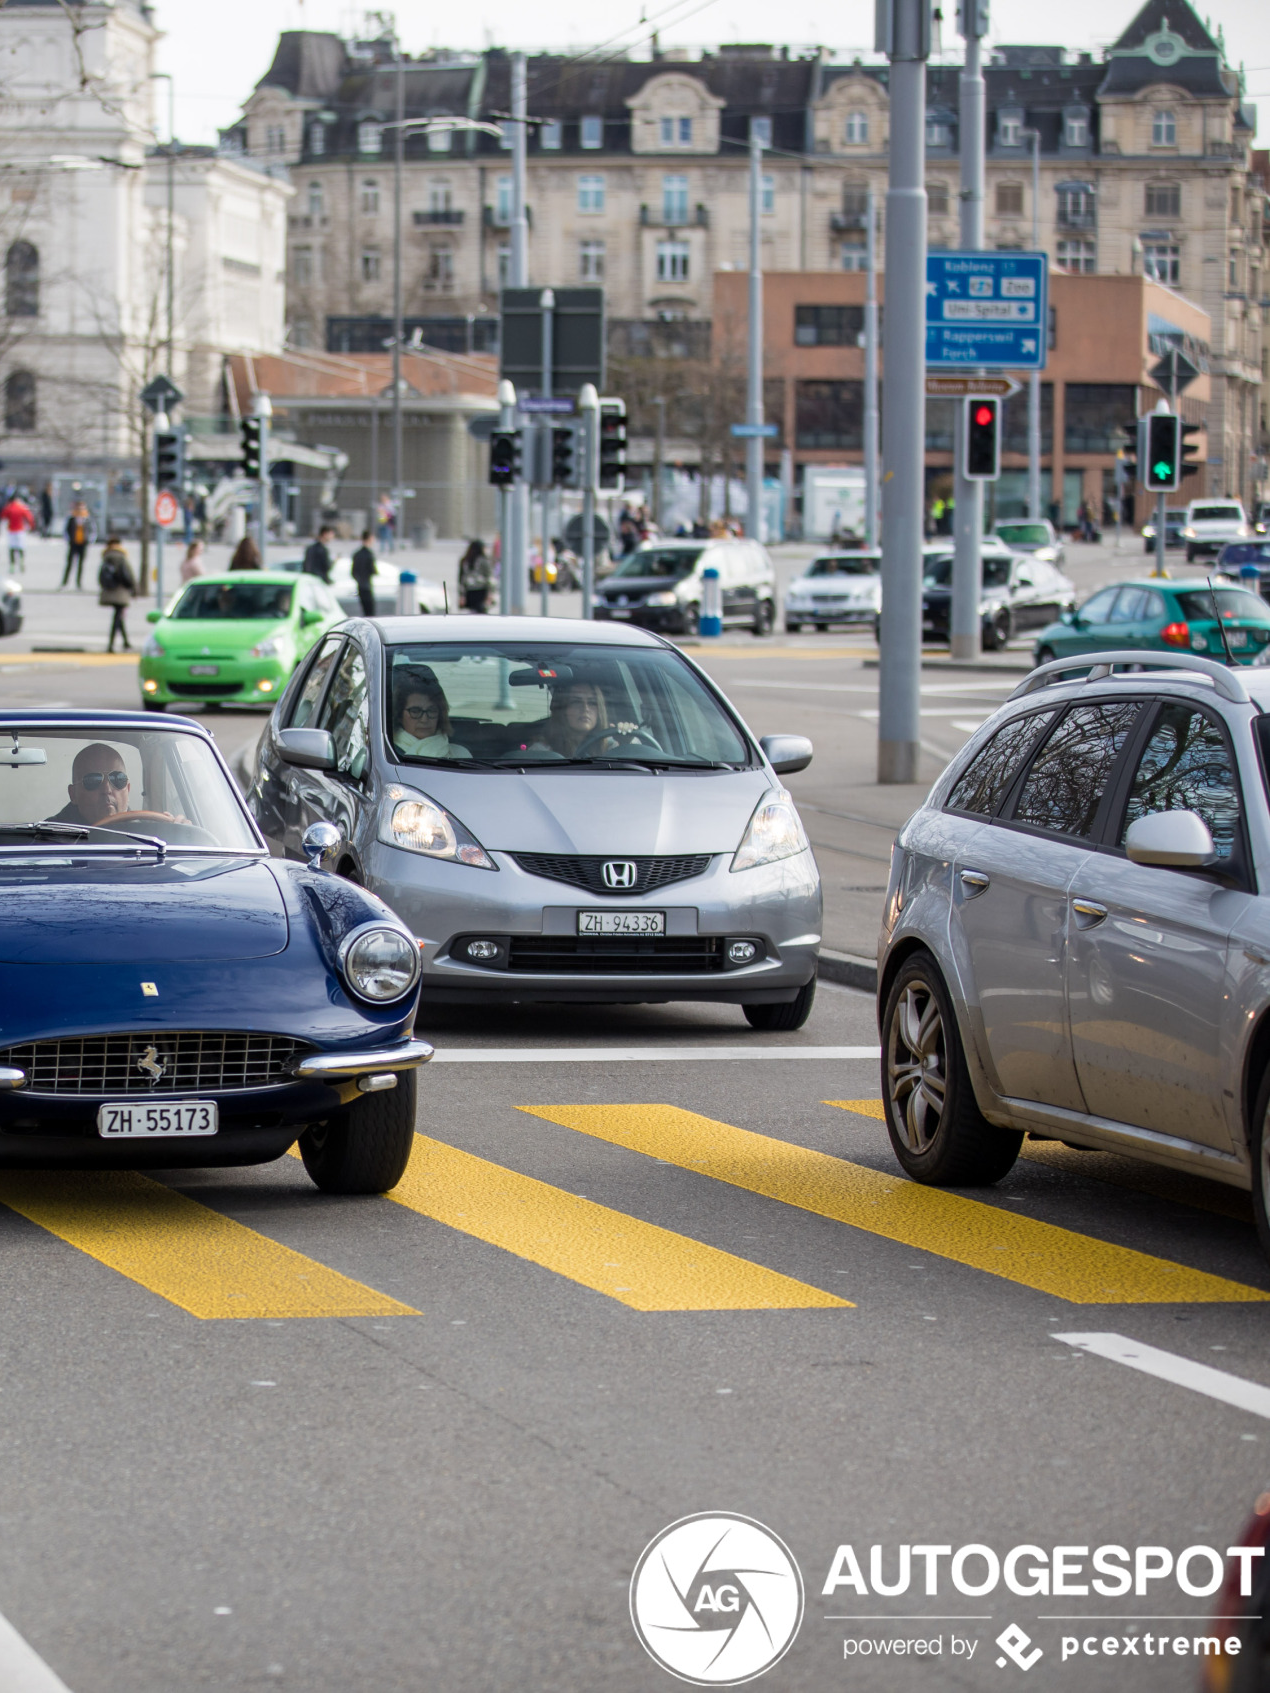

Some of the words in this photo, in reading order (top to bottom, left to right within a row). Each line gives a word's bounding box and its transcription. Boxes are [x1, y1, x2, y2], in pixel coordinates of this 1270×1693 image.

[944, 260, 995, 273] Koblenz
[1006, 281, 1030, 292] Zoo
[943, 330, 1014, 343] Rapperswil
[943, 347, 976, 358] Forch
